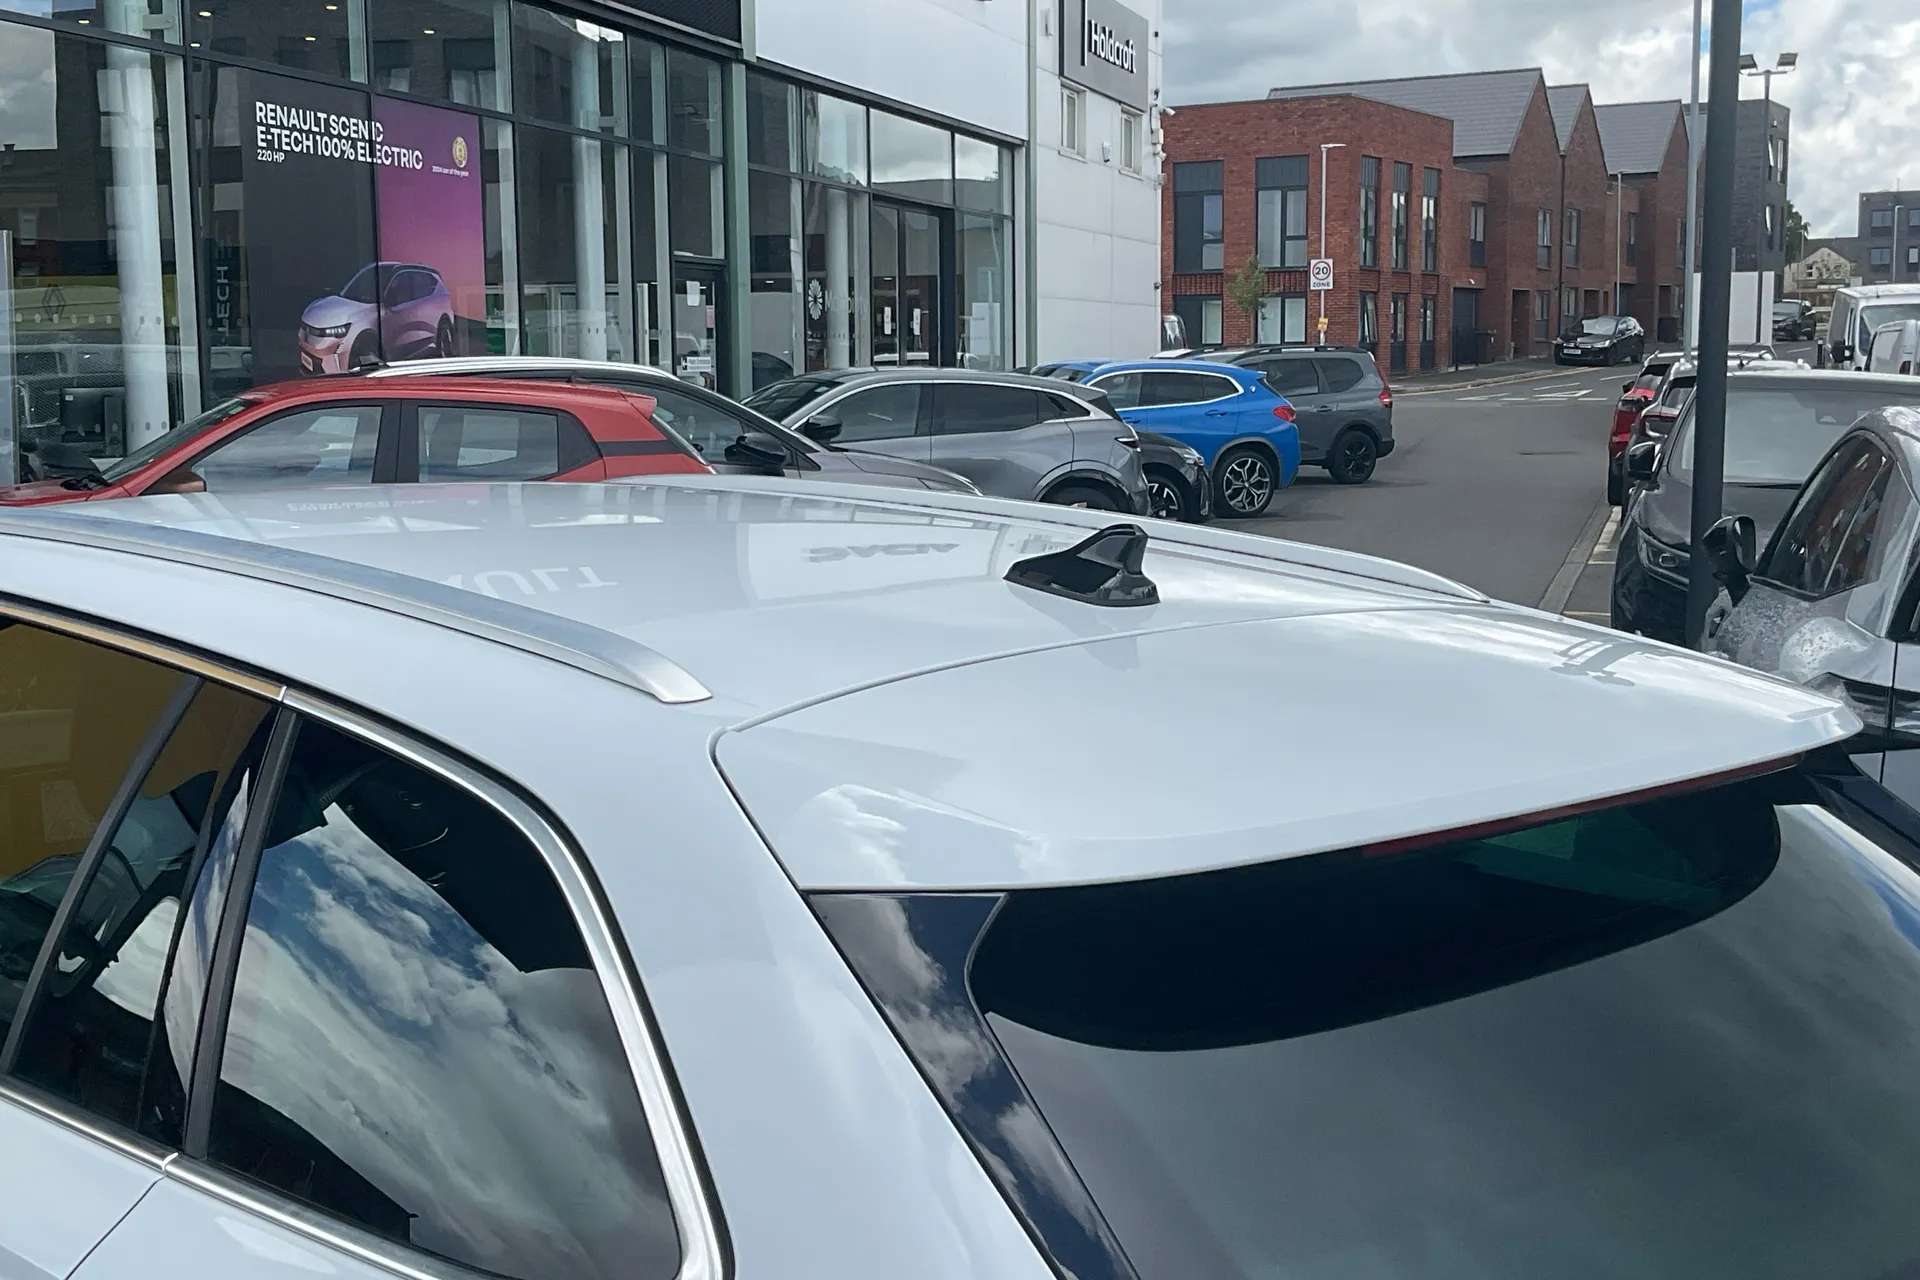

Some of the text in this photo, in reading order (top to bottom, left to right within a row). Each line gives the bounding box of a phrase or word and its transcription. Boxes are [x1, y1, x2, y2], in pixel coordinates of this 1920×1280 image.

[1090, 19, 1137, 74] Holdcroft
[255, 101, 384, 142] RENAULT SCENIC
[256, 125, 424, 170] E-TECH 100% ELECTRIC
[257, 149, 285, 163] 220 HP
[1315, 266, 1329, 275] 20
